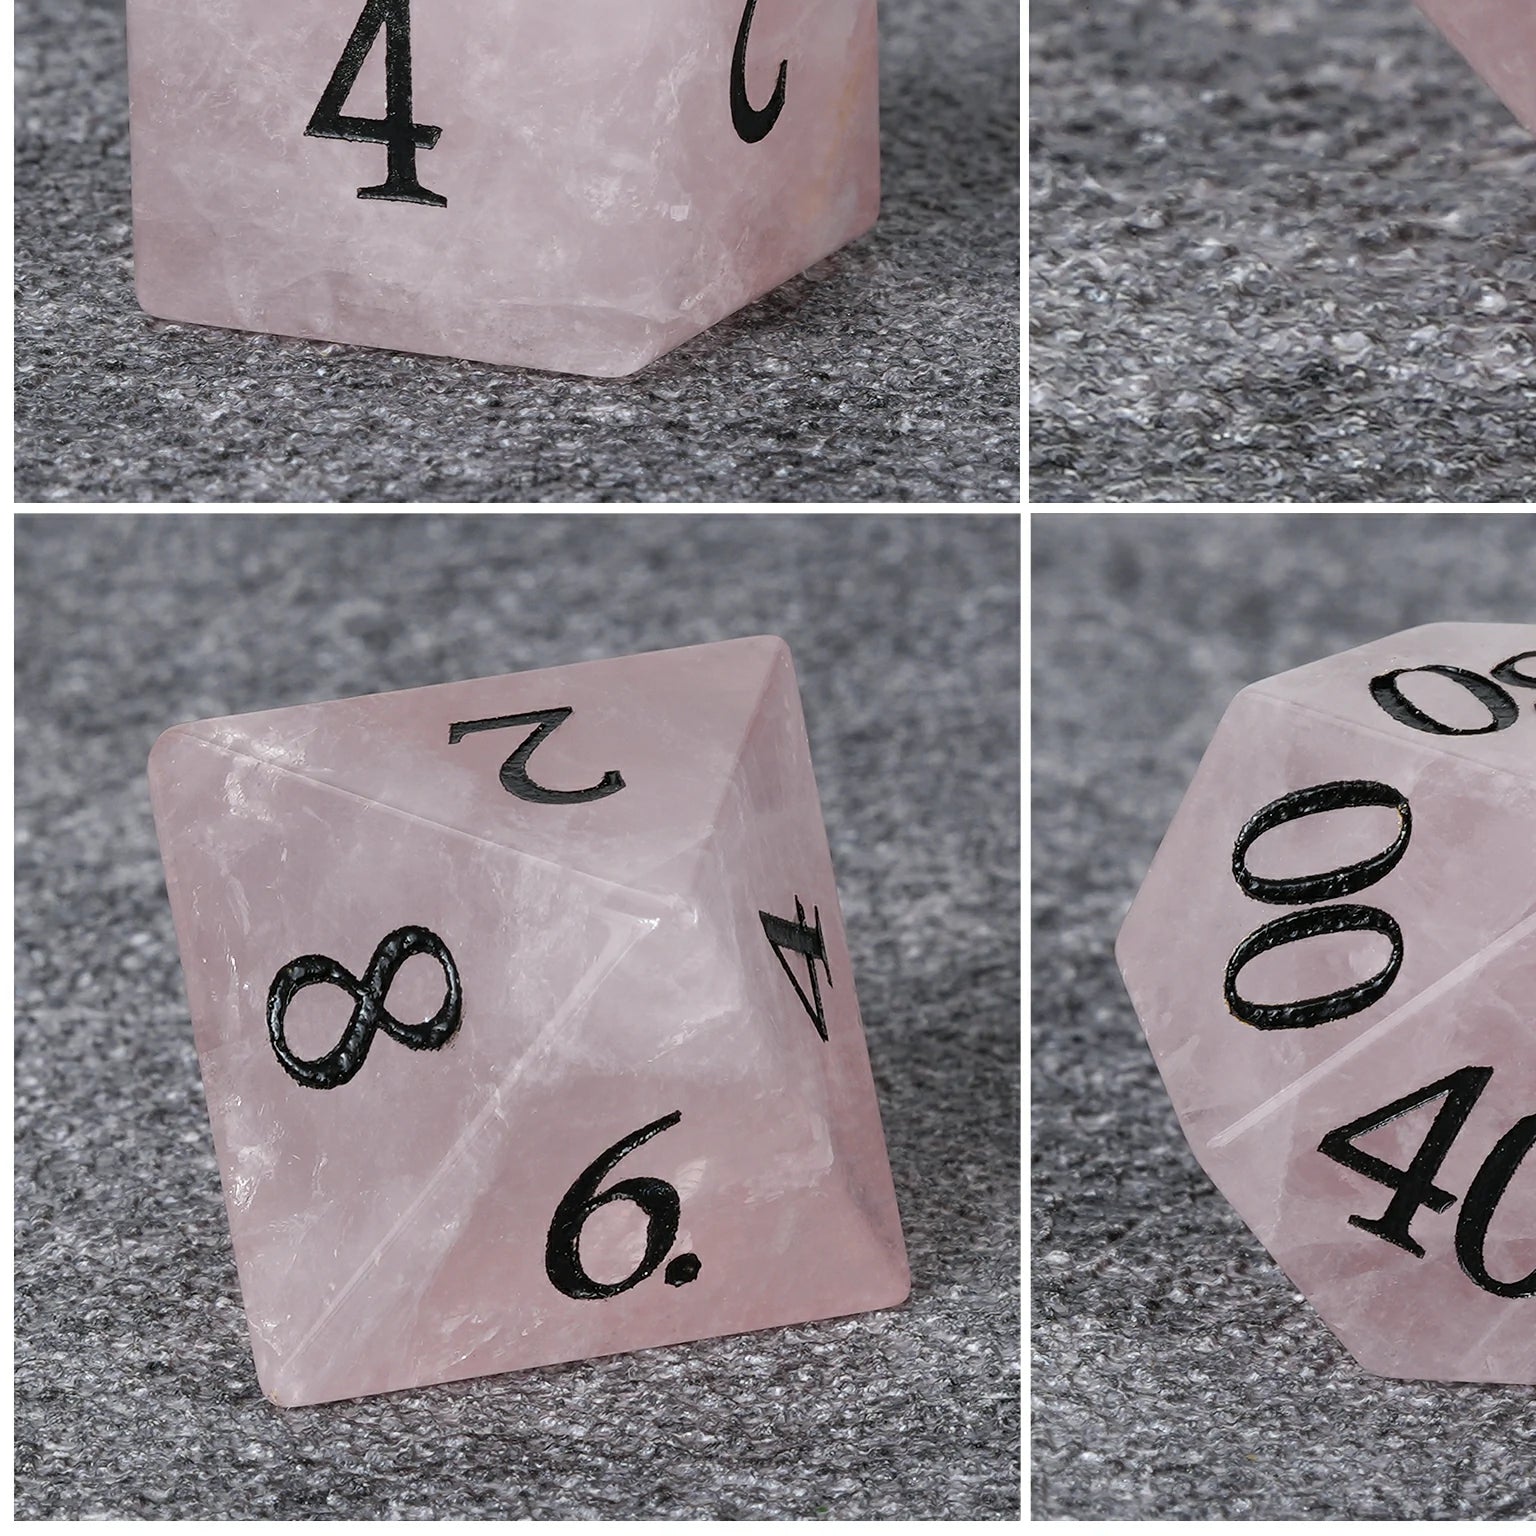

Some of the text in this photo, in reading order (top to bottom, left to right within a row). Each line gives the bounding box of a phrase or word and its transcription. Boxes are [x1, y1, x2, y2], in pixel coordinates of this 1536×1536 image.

[448, 707, 626, 804] 2
[759, 895, 833, 1042] 4
[1224, 780, 1412, 1031] 00
[266, 925, 462, 1090] 8
